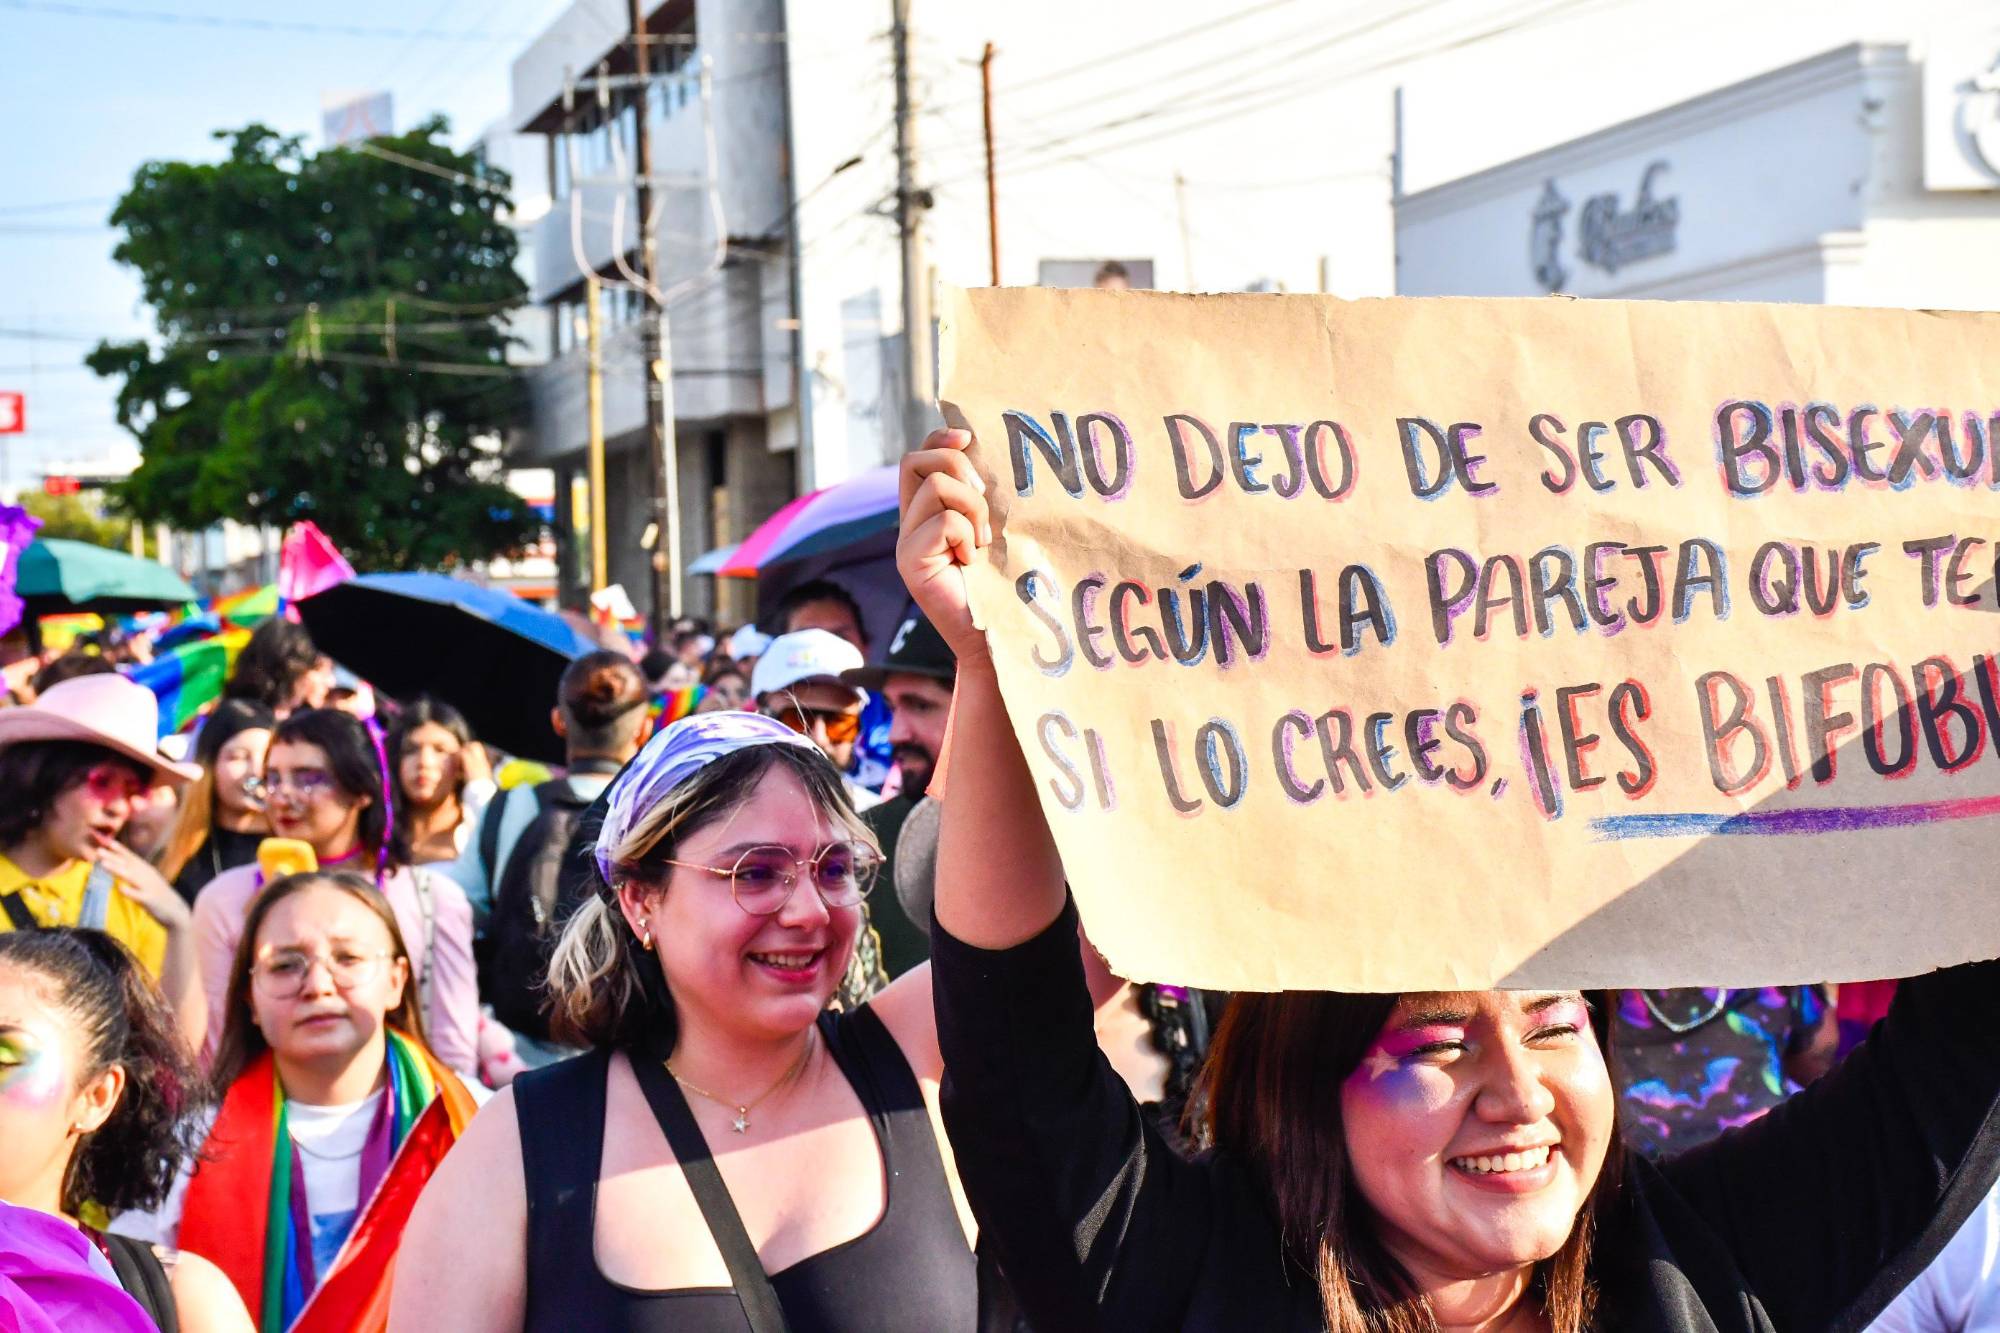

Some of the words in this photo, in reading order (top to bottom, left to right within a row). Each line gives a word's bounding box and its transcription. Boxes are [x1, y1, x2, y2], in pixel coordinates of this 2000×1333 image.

[1002, 409, 1137, 502] NO
[1163, 411, 1360, 504] DEJO
[1395, 415, 1500, 502] DE
[1528, 411, 1683, 497] SER
[1015, 561, 1271, 679] SEGÚN
[1299, 562, 1397, 659] LA
[1424, 536, 1732, 650] PAREJA
[1749, 538, 1882, 620] QUE
[1036, 708, 1117, 814] SI
[1150, 716, 1249, 819] LO
[1272, 696, 1508, 806] CREES,
